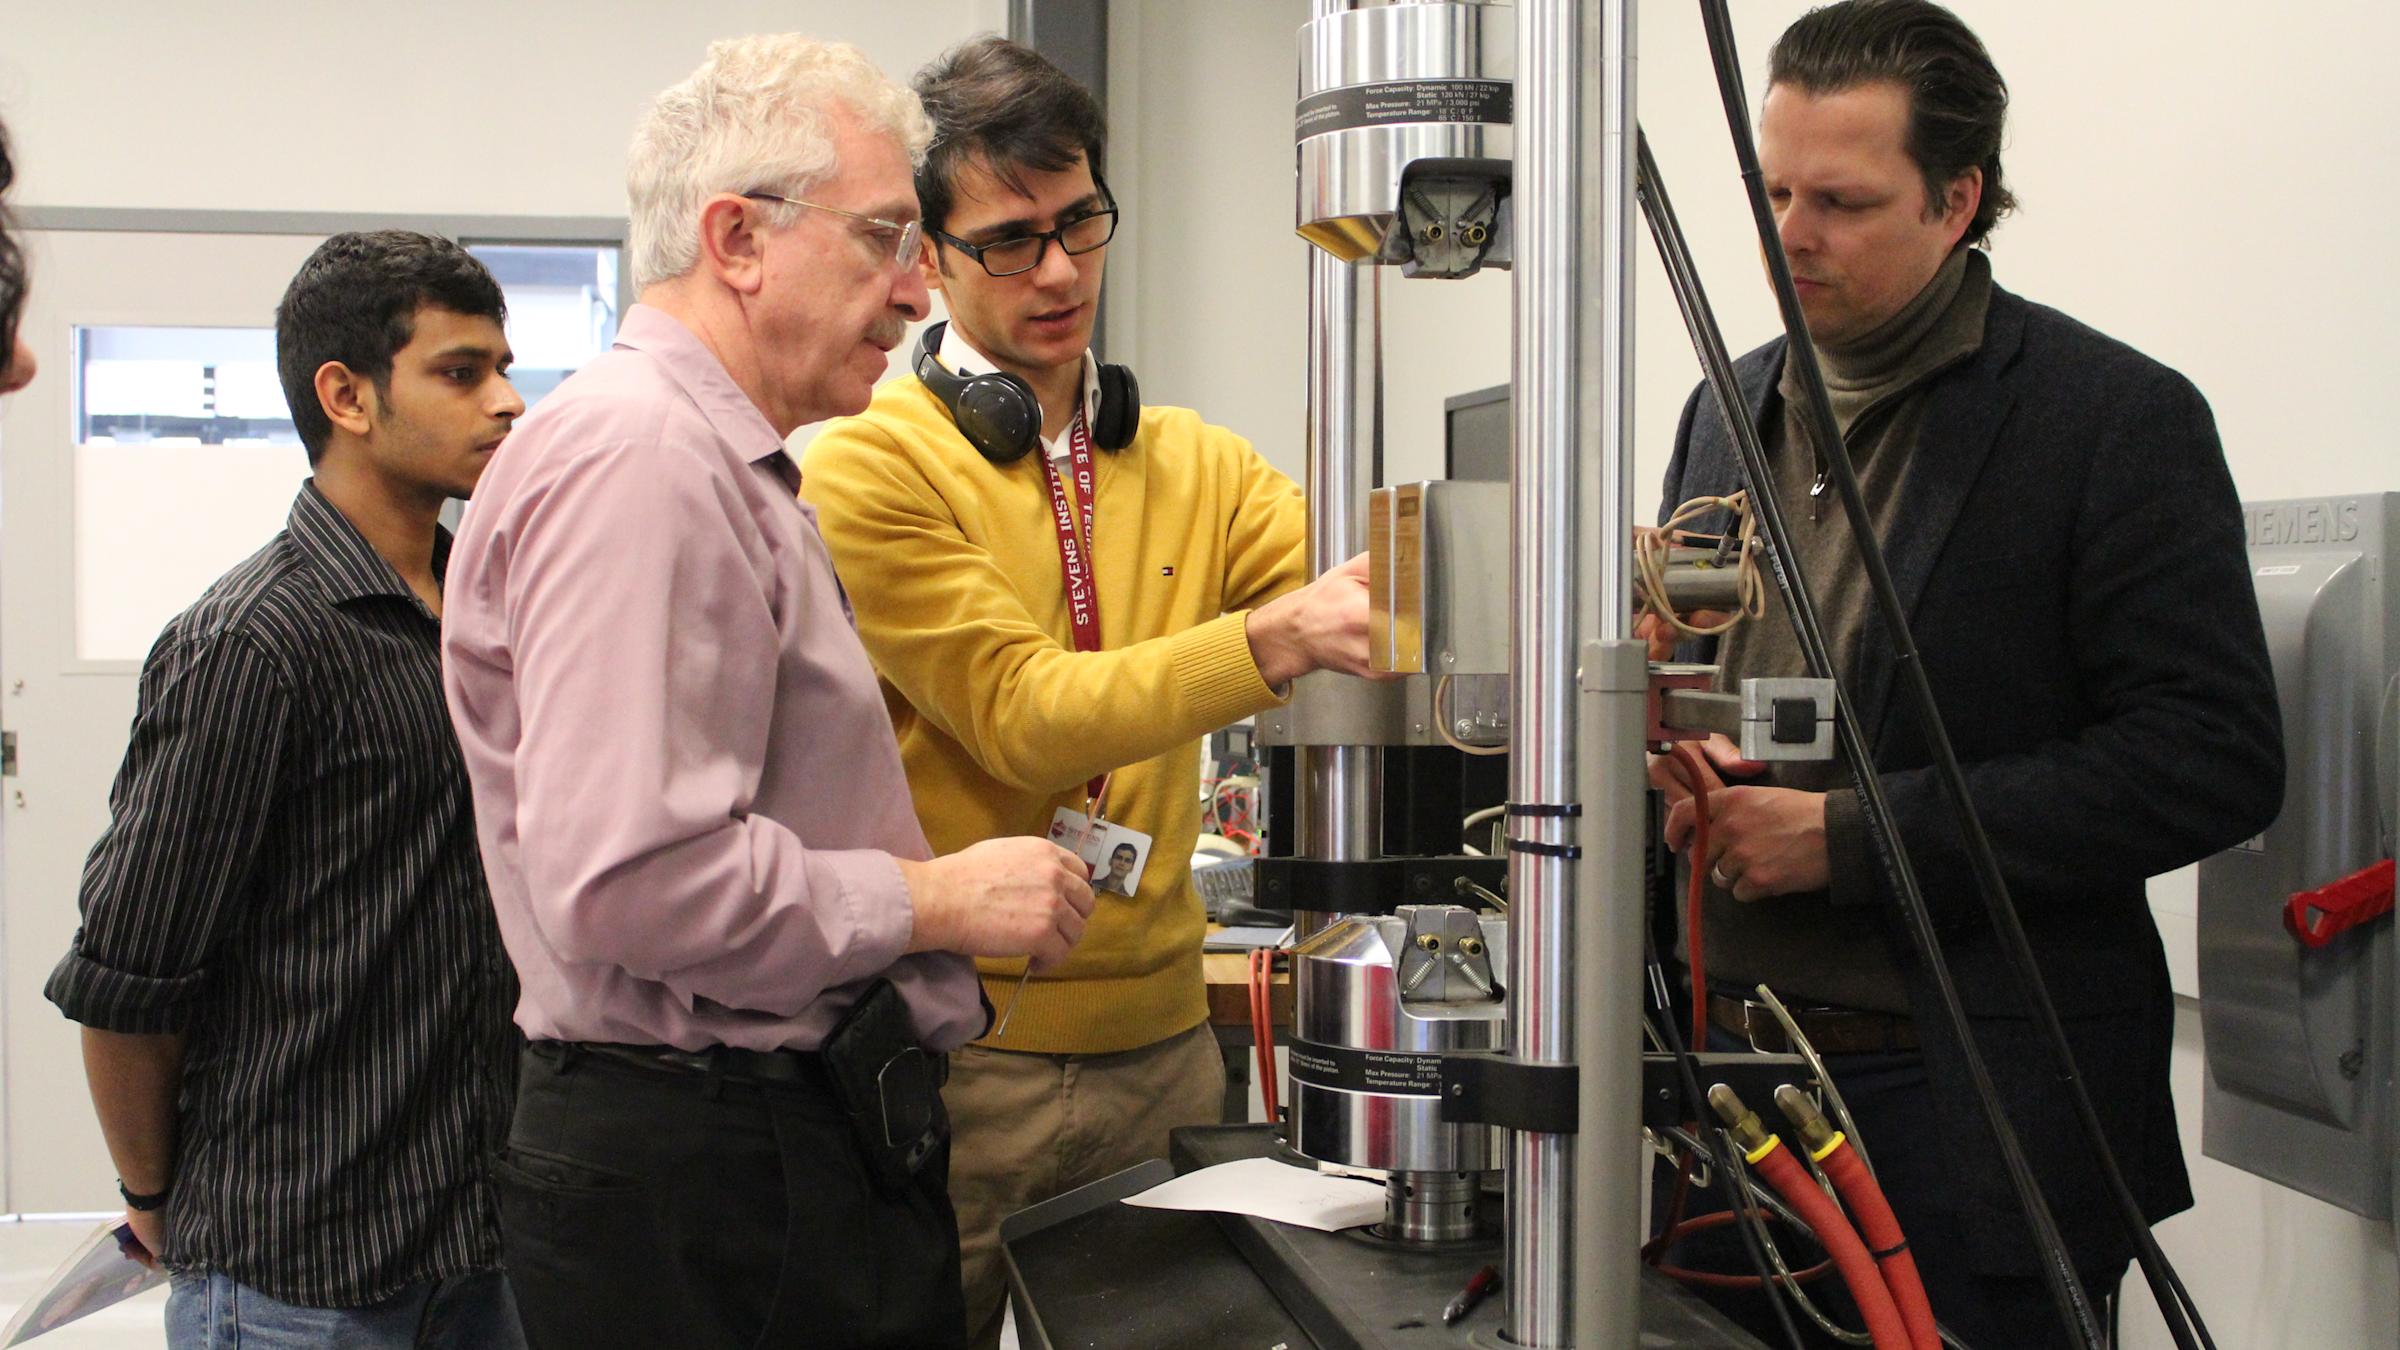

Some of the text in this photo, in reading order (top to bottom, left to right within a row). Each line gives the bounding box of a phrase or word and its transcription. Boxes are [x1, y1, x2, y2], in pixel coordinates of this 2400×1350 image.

[1365, 87, 1383, 95] Force
[1416, 84, 1447, 92] Dynamic
[1365, 102, 1379, 110] Max
[1365, 109, 1407, 118] Temperature
[1078, 471, 1091, 495] OF
[2245, 501, 2359, 546] IEMENS
[1063, 538, 1088, 625] STEVENS
[1365, 1053, 1383, 1062] Force
[1416, 1057, 1442, 1065] Dynam
[1416, 1064, 1438, 1072] Static
[1366, 1077, 1407, 1087] Temperature
